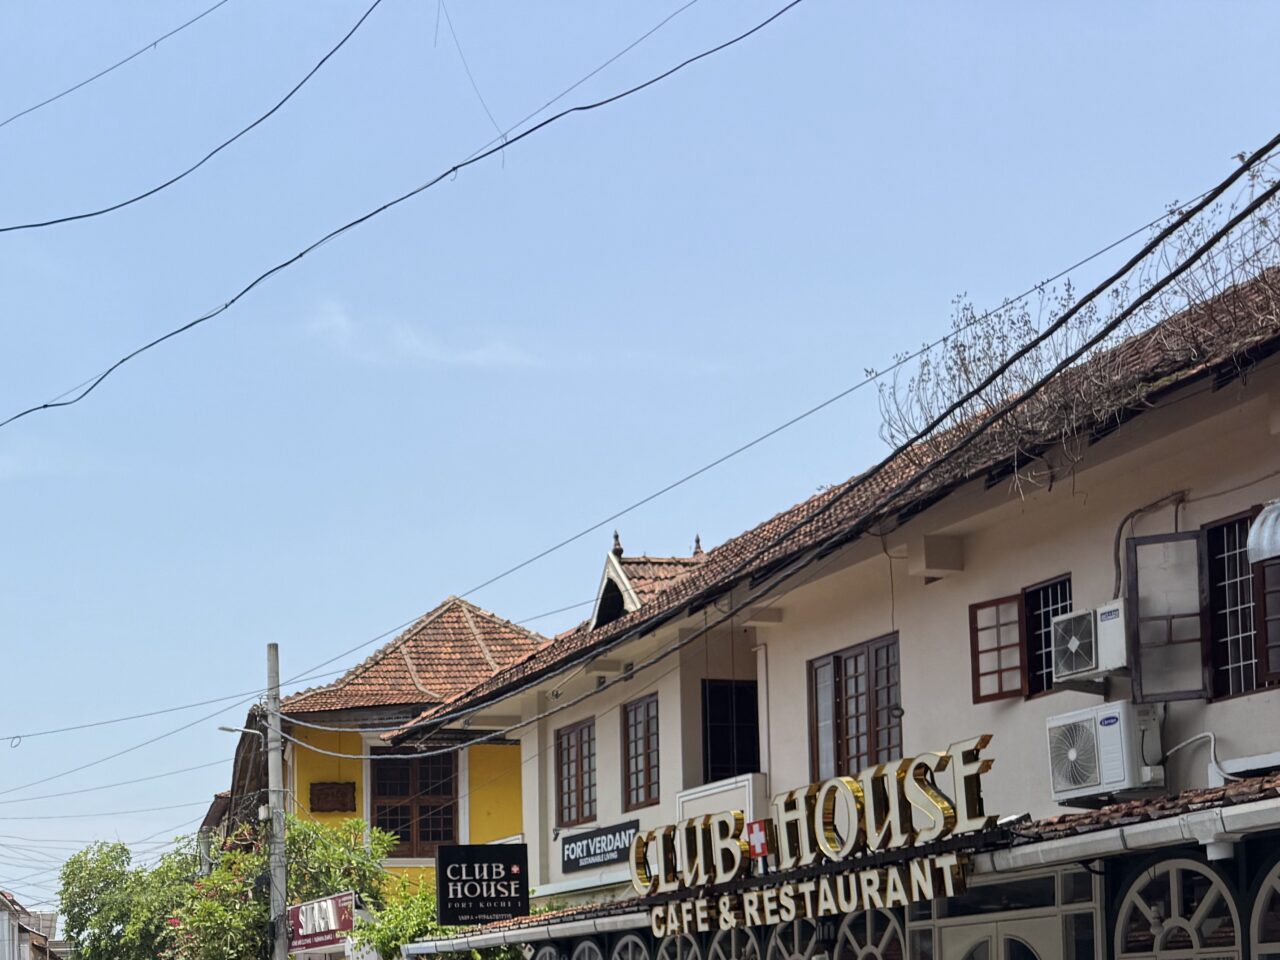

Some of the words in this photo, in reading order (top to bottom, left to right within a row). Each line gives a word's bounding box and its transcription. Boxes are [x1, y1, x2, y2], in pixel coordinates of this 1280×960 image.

[628, 810, 748, 896] CLUB
[772, 734, 1000, 869] HOUSE
[564, 840, 588, 861] FORT
[588, 829, 636, 855] VERDANT
[446, 863, 505, 880] CLUB
[447, 881, 520, 898] HOUSE
[719, 896, 742, 930] &
[743, 854, 960, 927] RESTAURANT
[448, 901, 473, 909] FORT
